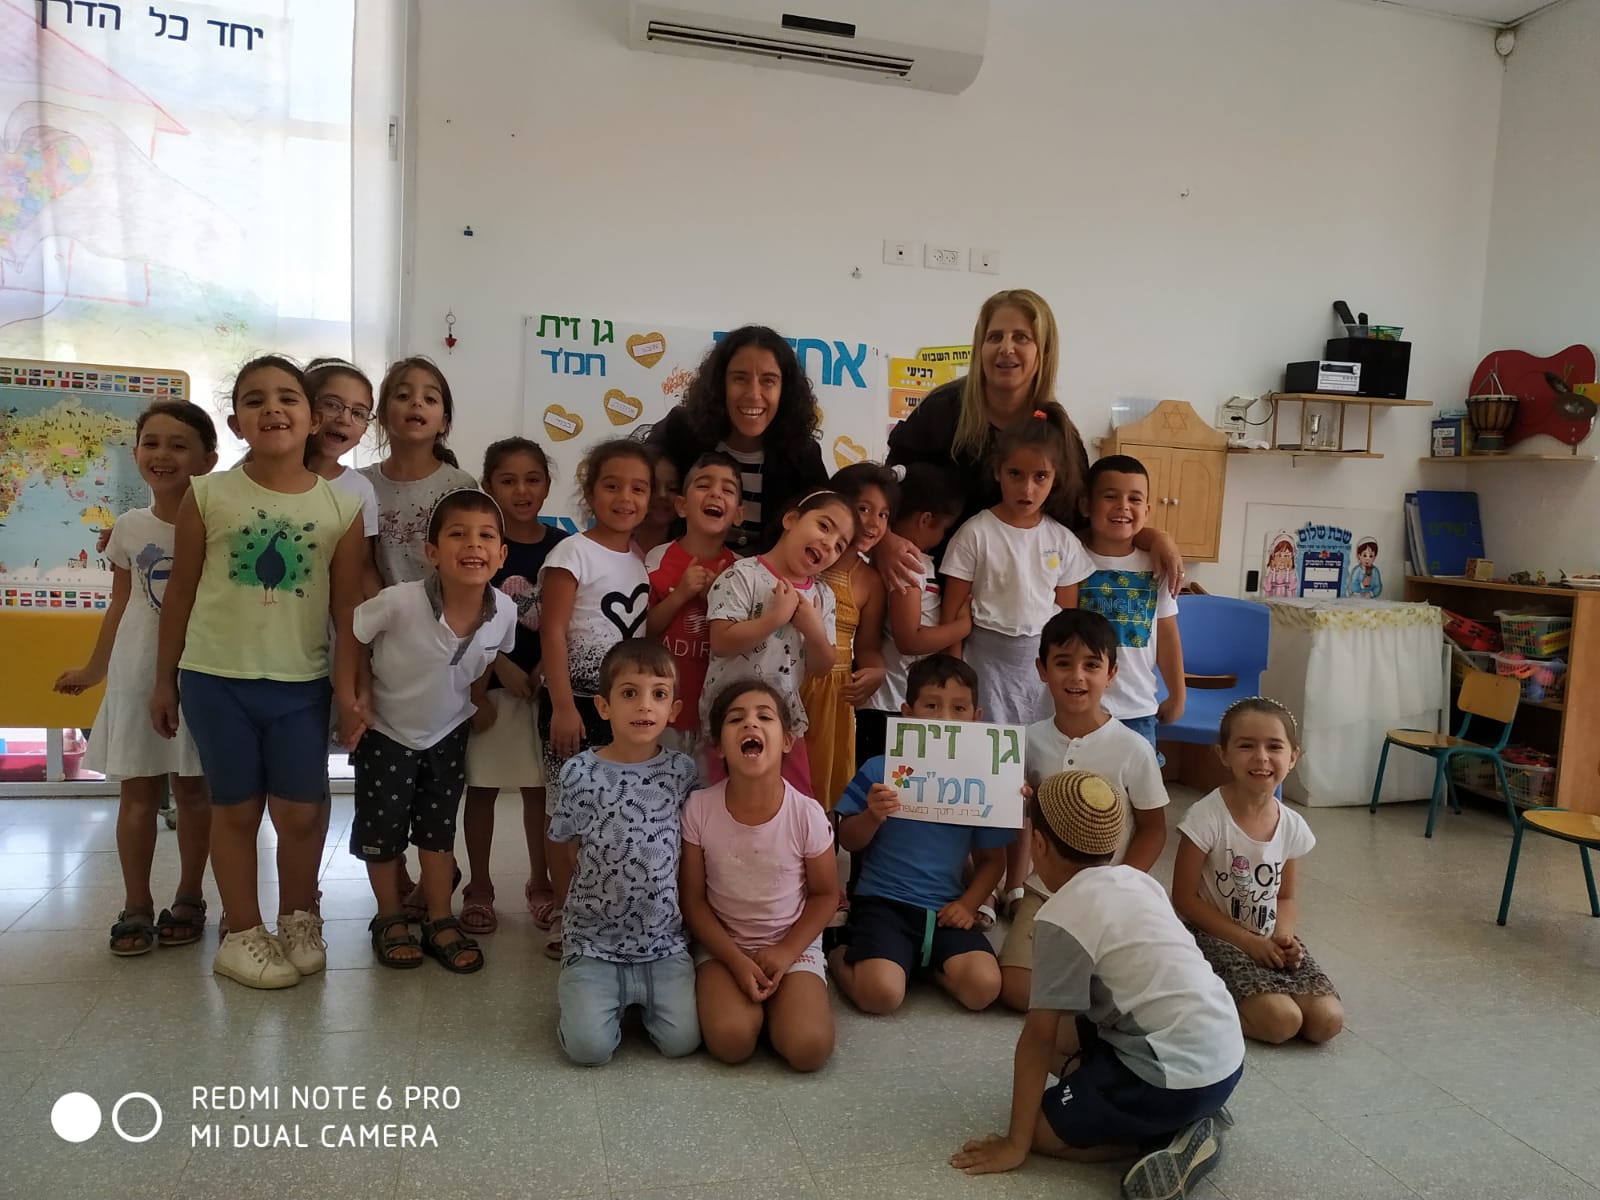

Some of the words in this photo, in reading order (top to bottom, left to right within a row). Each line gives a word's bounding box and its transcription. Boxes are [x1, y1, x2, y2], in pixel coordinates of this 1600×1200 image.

[149, 6, 189, 42] כל
[206, 19, 264, 50] יחד
[536, 314, 581, 341] זית
[591, 318, 614, 346] גן
[907, 366, 933, 378] רביעי
[1298, 520, 1326, 542] שלום
[1327, 525, 1352, 544] שבת
[889, 722, 962, 760] זית
[986, 728, 1021, 775] גן
